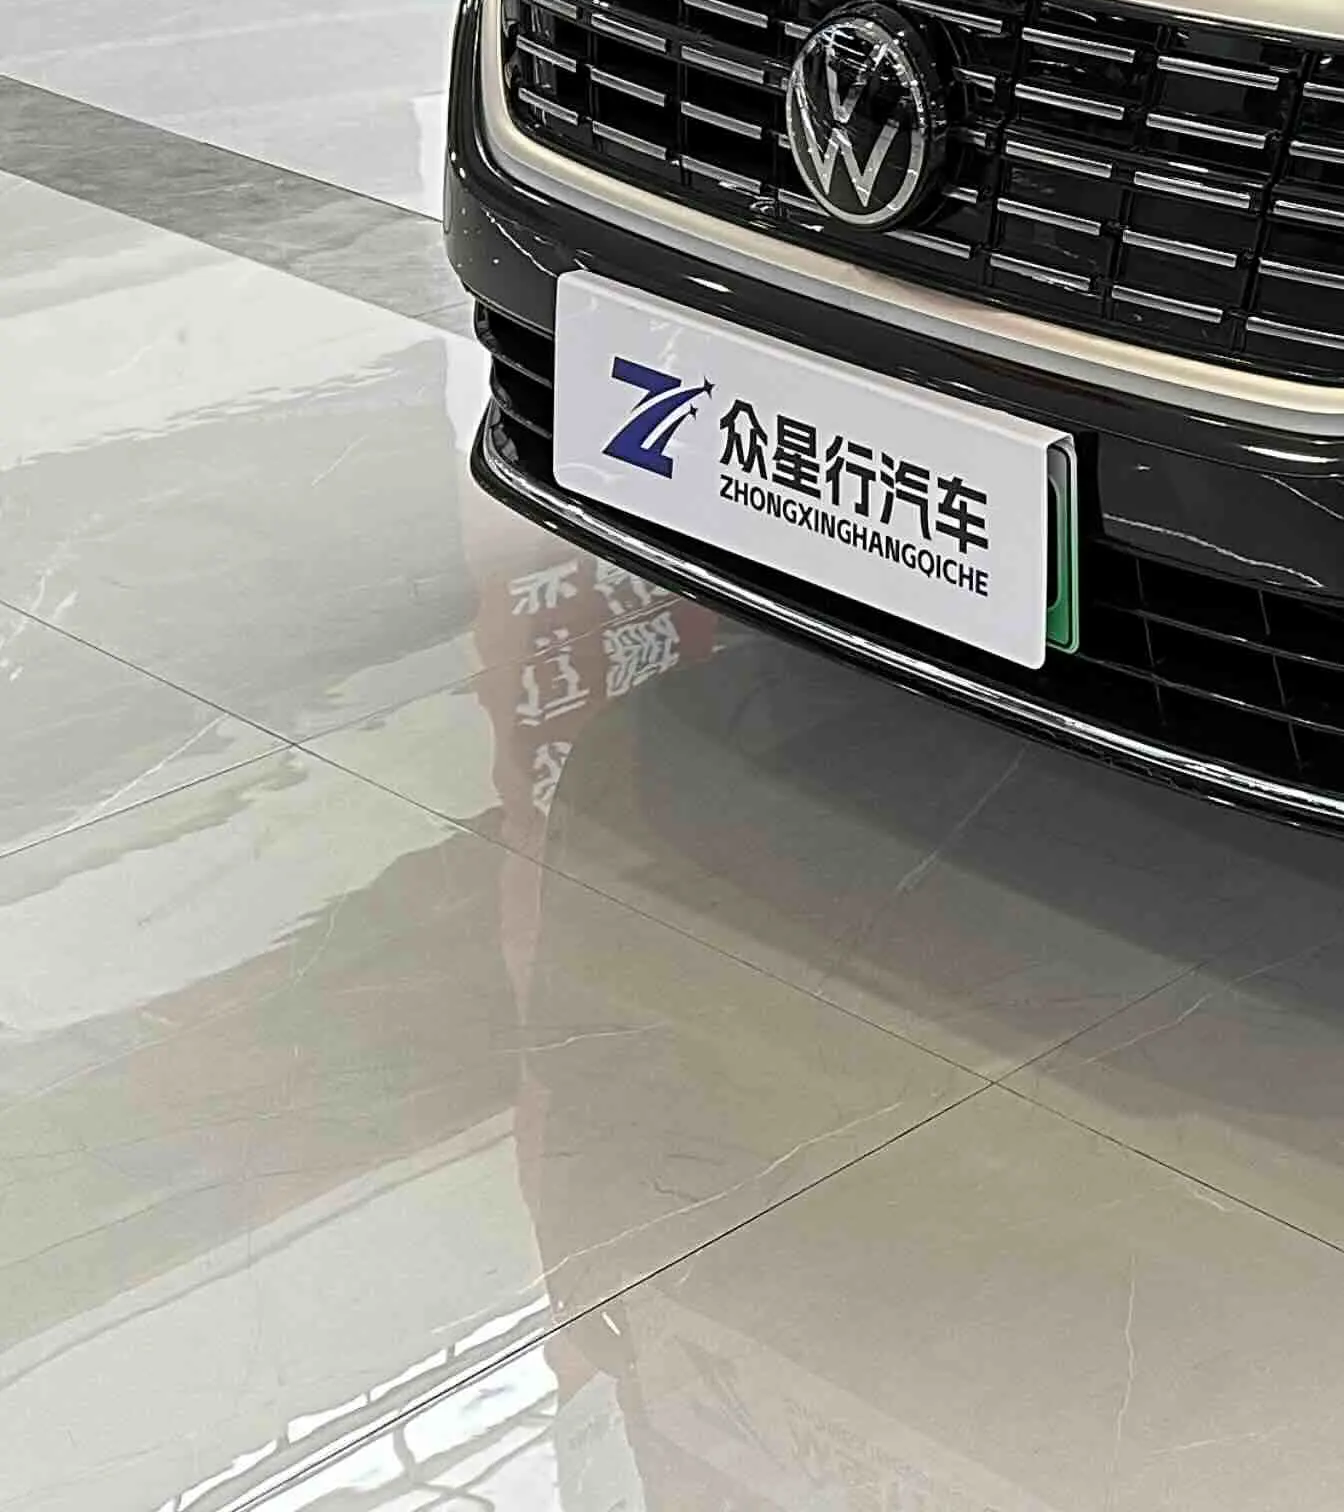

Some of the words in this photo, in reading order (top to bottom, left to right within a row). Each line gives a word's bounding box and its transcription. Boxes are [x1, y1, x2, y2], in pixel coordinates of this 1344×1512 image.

[719, 399, 989, 555] 众星行汽车
[719, 473, 989, 598] ZHONGXINGHANGQICHE
